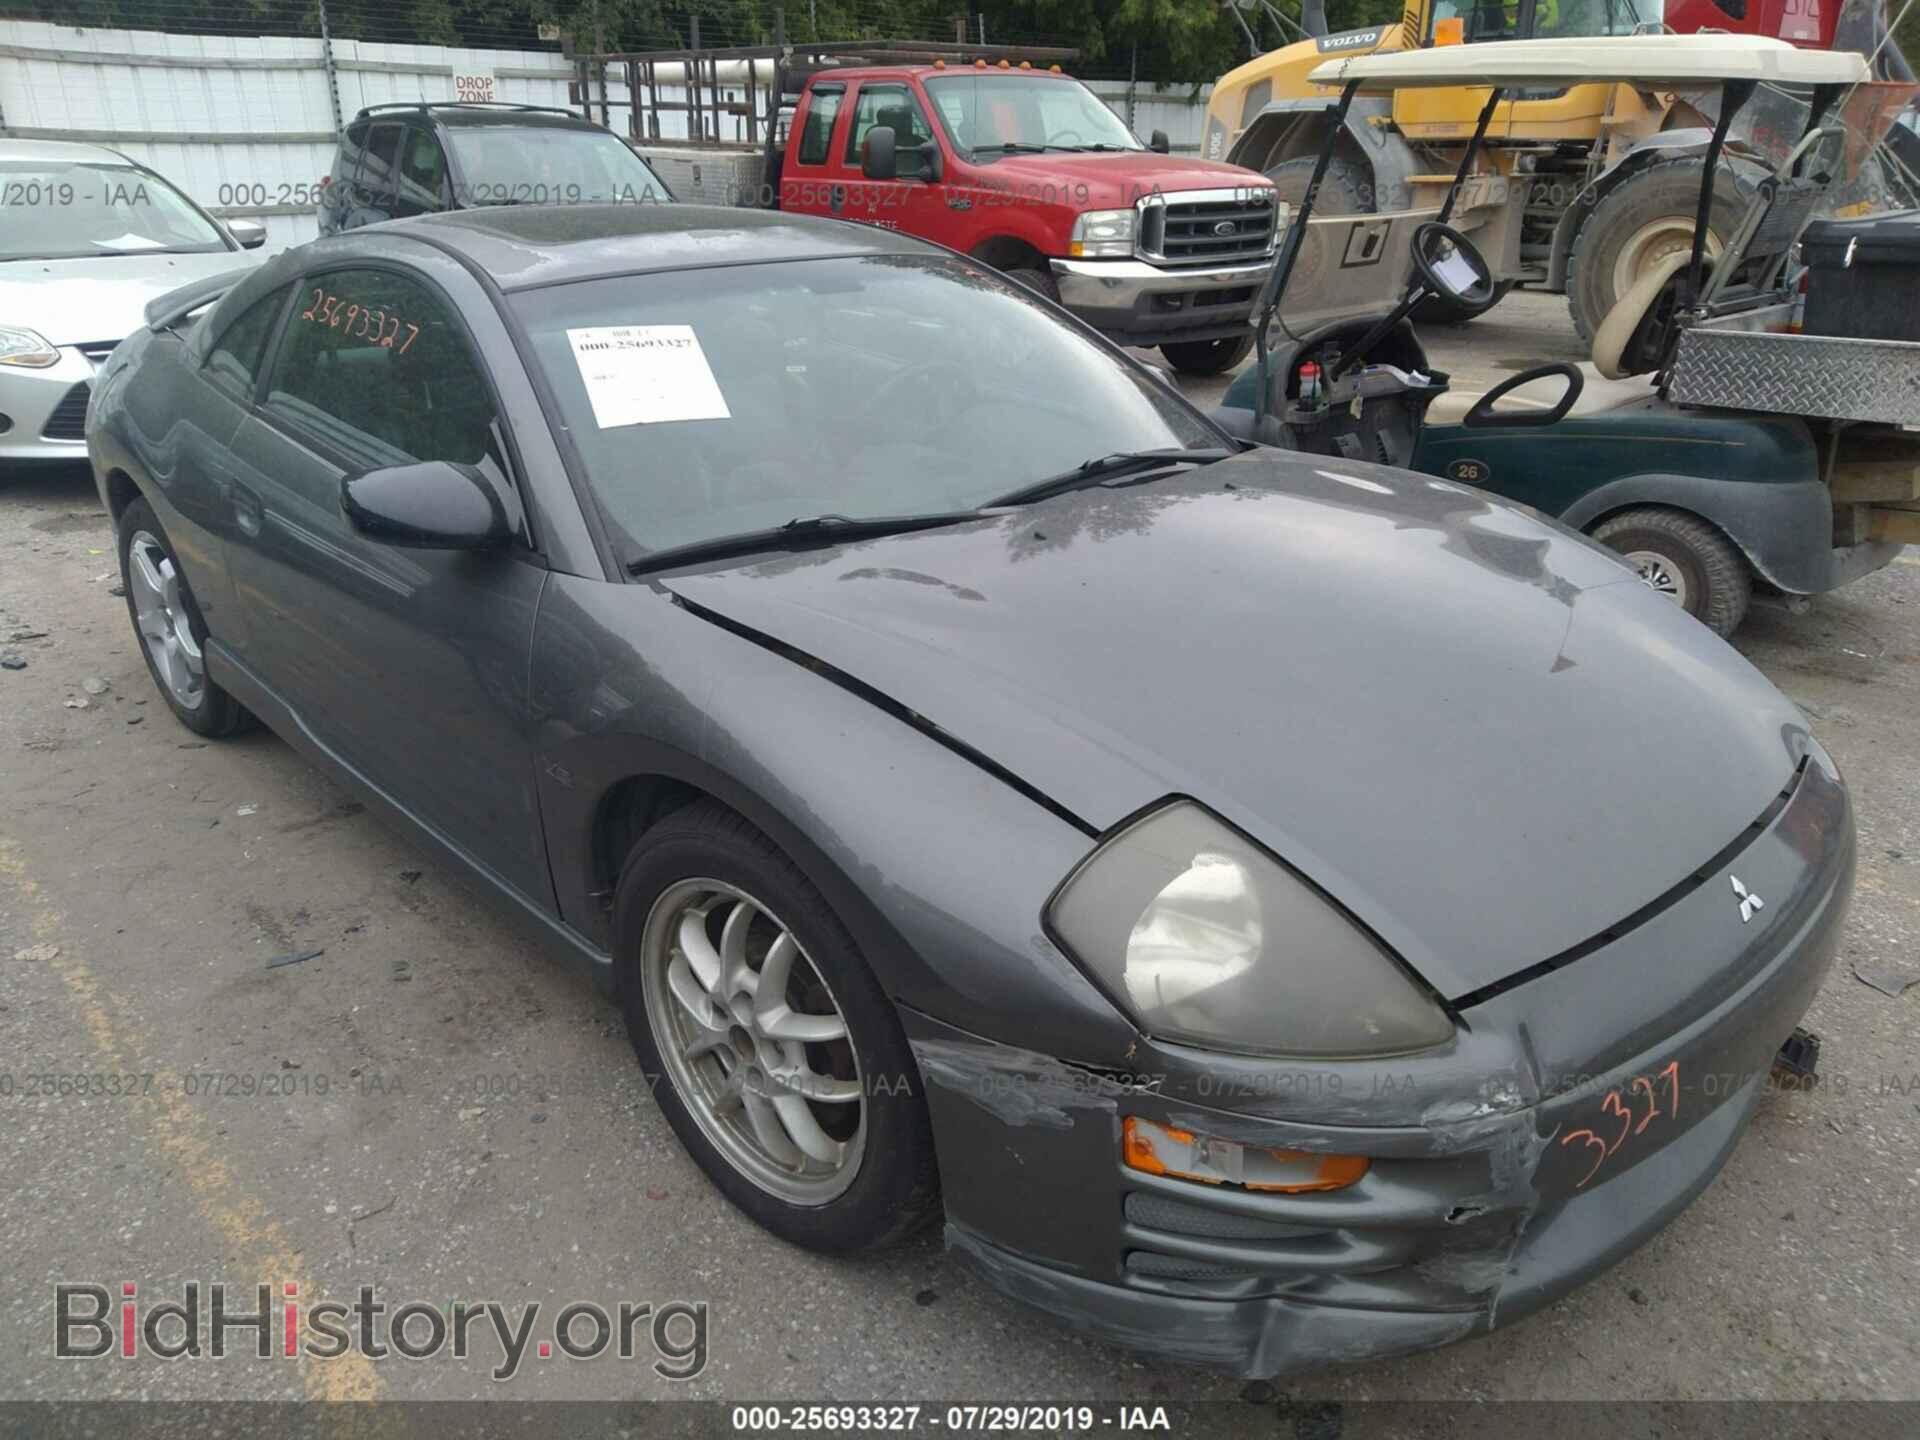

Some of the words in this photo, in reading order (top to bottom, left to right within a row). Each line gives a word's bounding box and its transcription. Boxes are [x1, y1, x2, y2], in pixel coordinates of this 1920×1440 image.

[1323, 33, 1377, 48] VOLVO
[455, 76, 493, 89] DROP
[457, 90, 494, 104] ZONE
[302, 288, 418, 354] 25693327
[1458, 464, 1478, 479] 26
